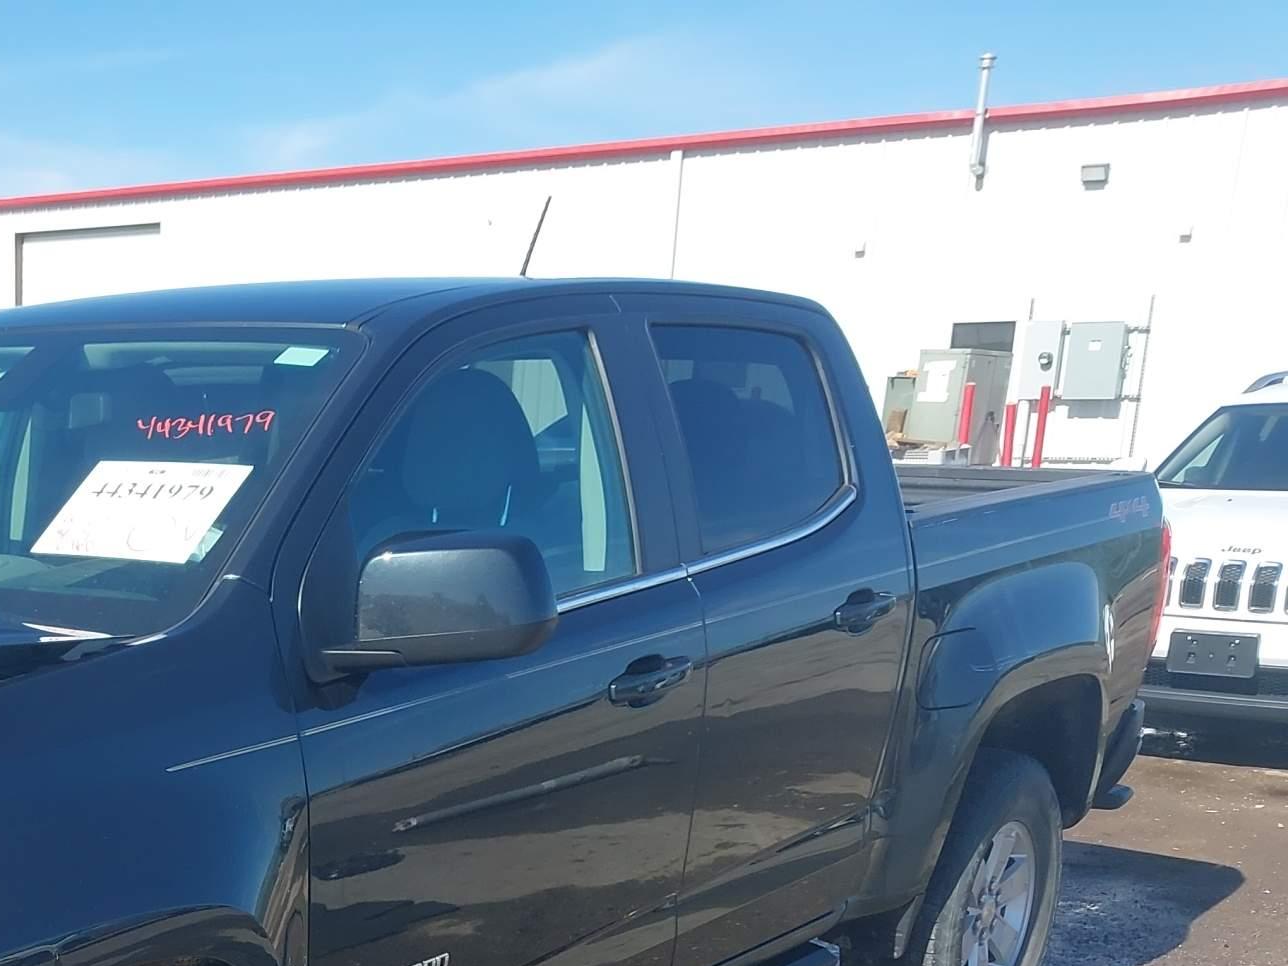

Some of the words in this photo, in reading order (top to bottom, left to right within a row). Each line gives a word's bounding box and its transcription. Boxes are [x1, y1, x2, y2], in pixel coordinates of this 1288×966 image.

[136, 410, 276, 440] 44341979
[91, 481, 216, 501] 44341979
[1221, 545, 1263, 555] Jeep
